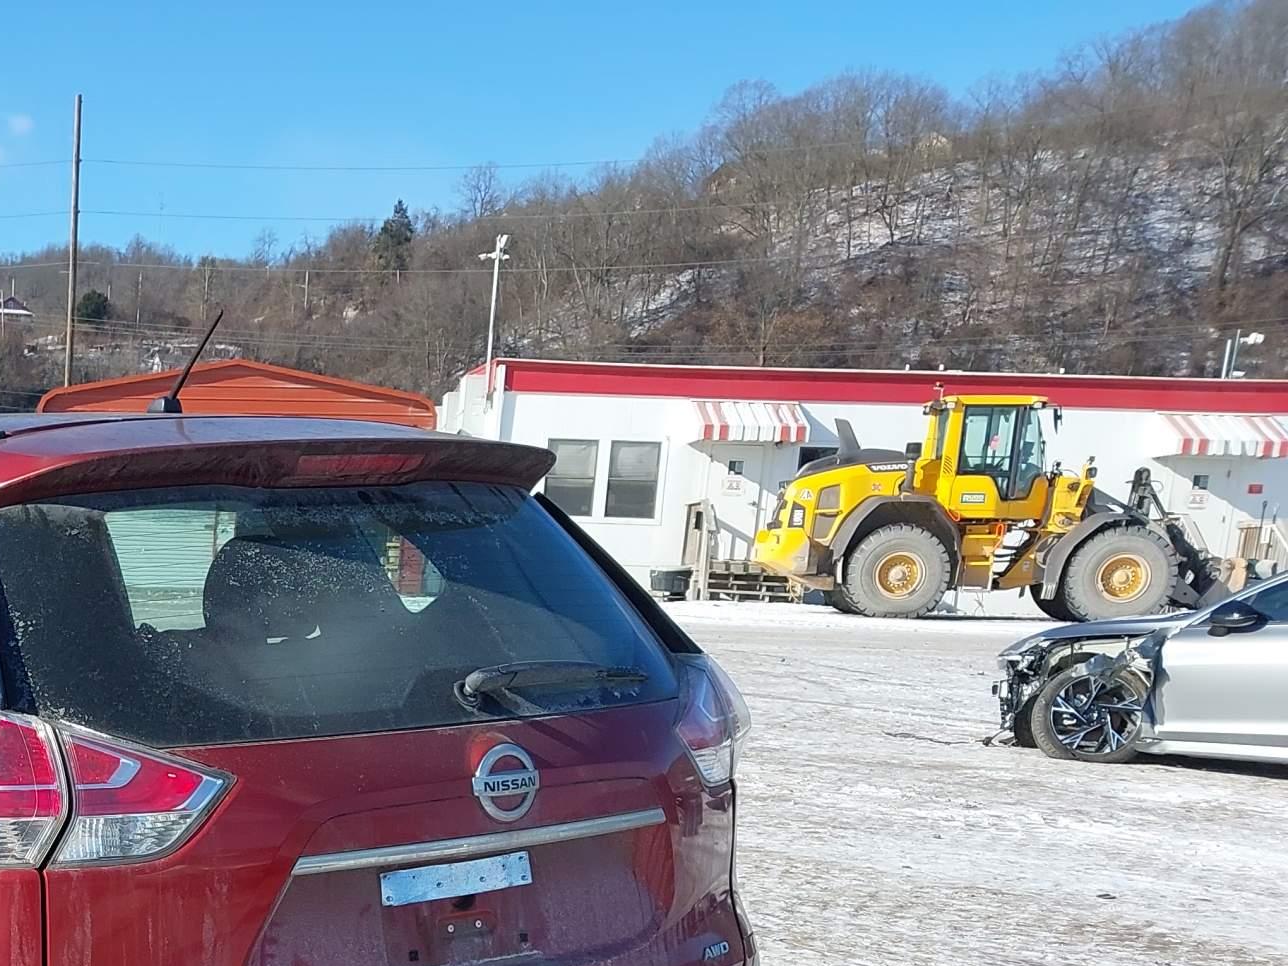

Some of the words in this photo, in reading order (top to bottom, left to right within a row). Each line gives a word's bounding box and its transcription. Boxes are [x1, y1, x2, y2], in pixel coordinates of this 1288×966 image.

[871, 463, 909, 471] VOLVO
[483, 775, 537, 793] NISSAN
[703, 941, 730, 961] AWD
